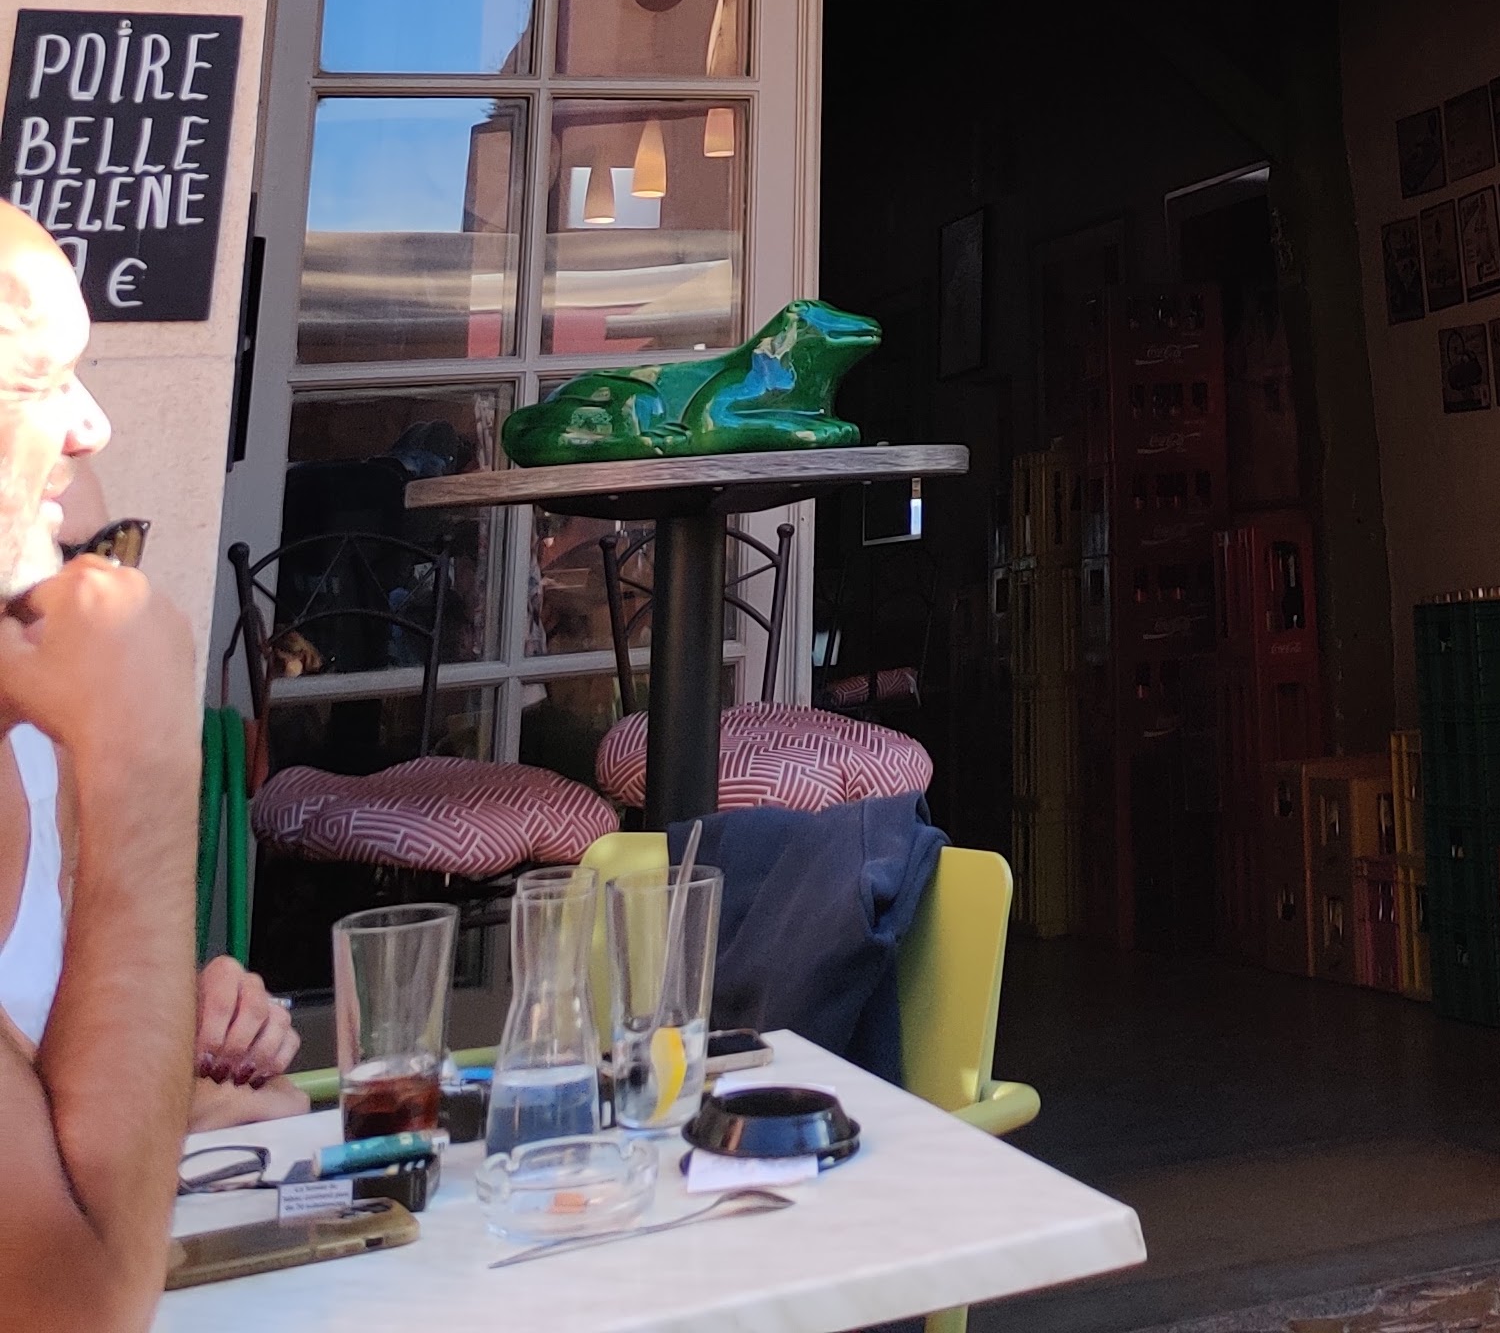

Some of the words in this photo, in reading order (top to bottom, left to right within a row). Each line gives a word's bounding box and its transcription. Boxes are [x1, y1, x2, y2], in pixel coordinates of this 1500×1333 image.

[29, 27, 220, 103] POIRE
[16, 115, 210, 176] BELLE
[10, 173, 209, 231] HELENE
